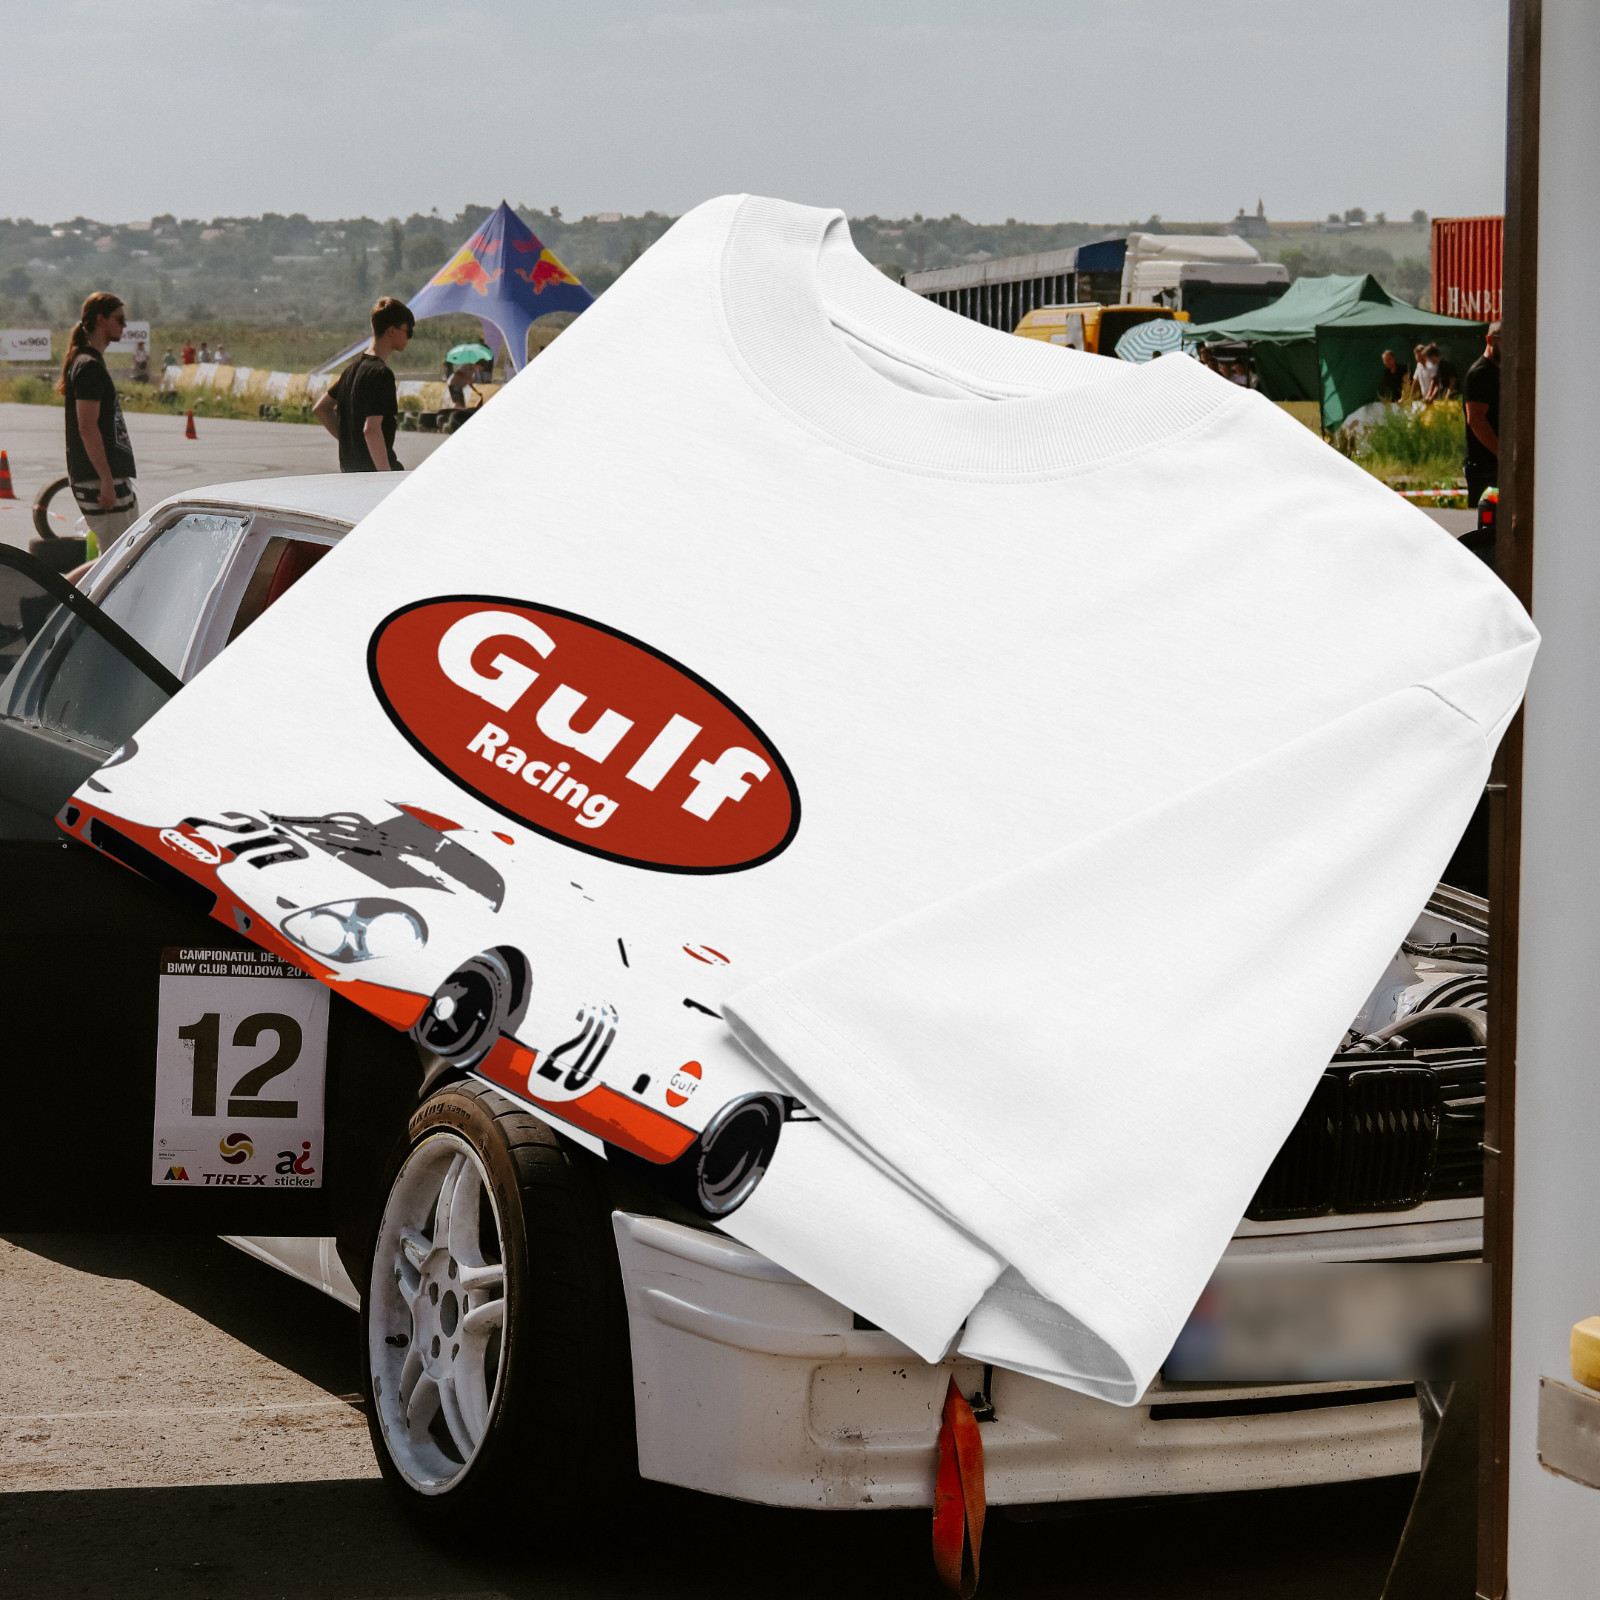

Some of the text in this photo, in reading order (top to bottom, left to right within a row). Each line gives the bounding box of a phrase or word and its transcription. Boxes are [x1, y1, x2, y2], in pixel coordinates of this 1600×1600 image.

[437, 610, 771, 822] Gulf
[466, 721, 619, 829] Racing
[179, 949, 257, 963] CAMPIONATUL
[260, 952, 275, 963] DE
[167, 962, 195, 974] BMW
[199, 963, 228, 975] CLUB
[231, 964, 283, 977] MOLDOVA
[178, 1011, 303, 1119] 12
[669, 1072, 699, 1095] Gulf
[274, 1176, 316, 1187] sticker
